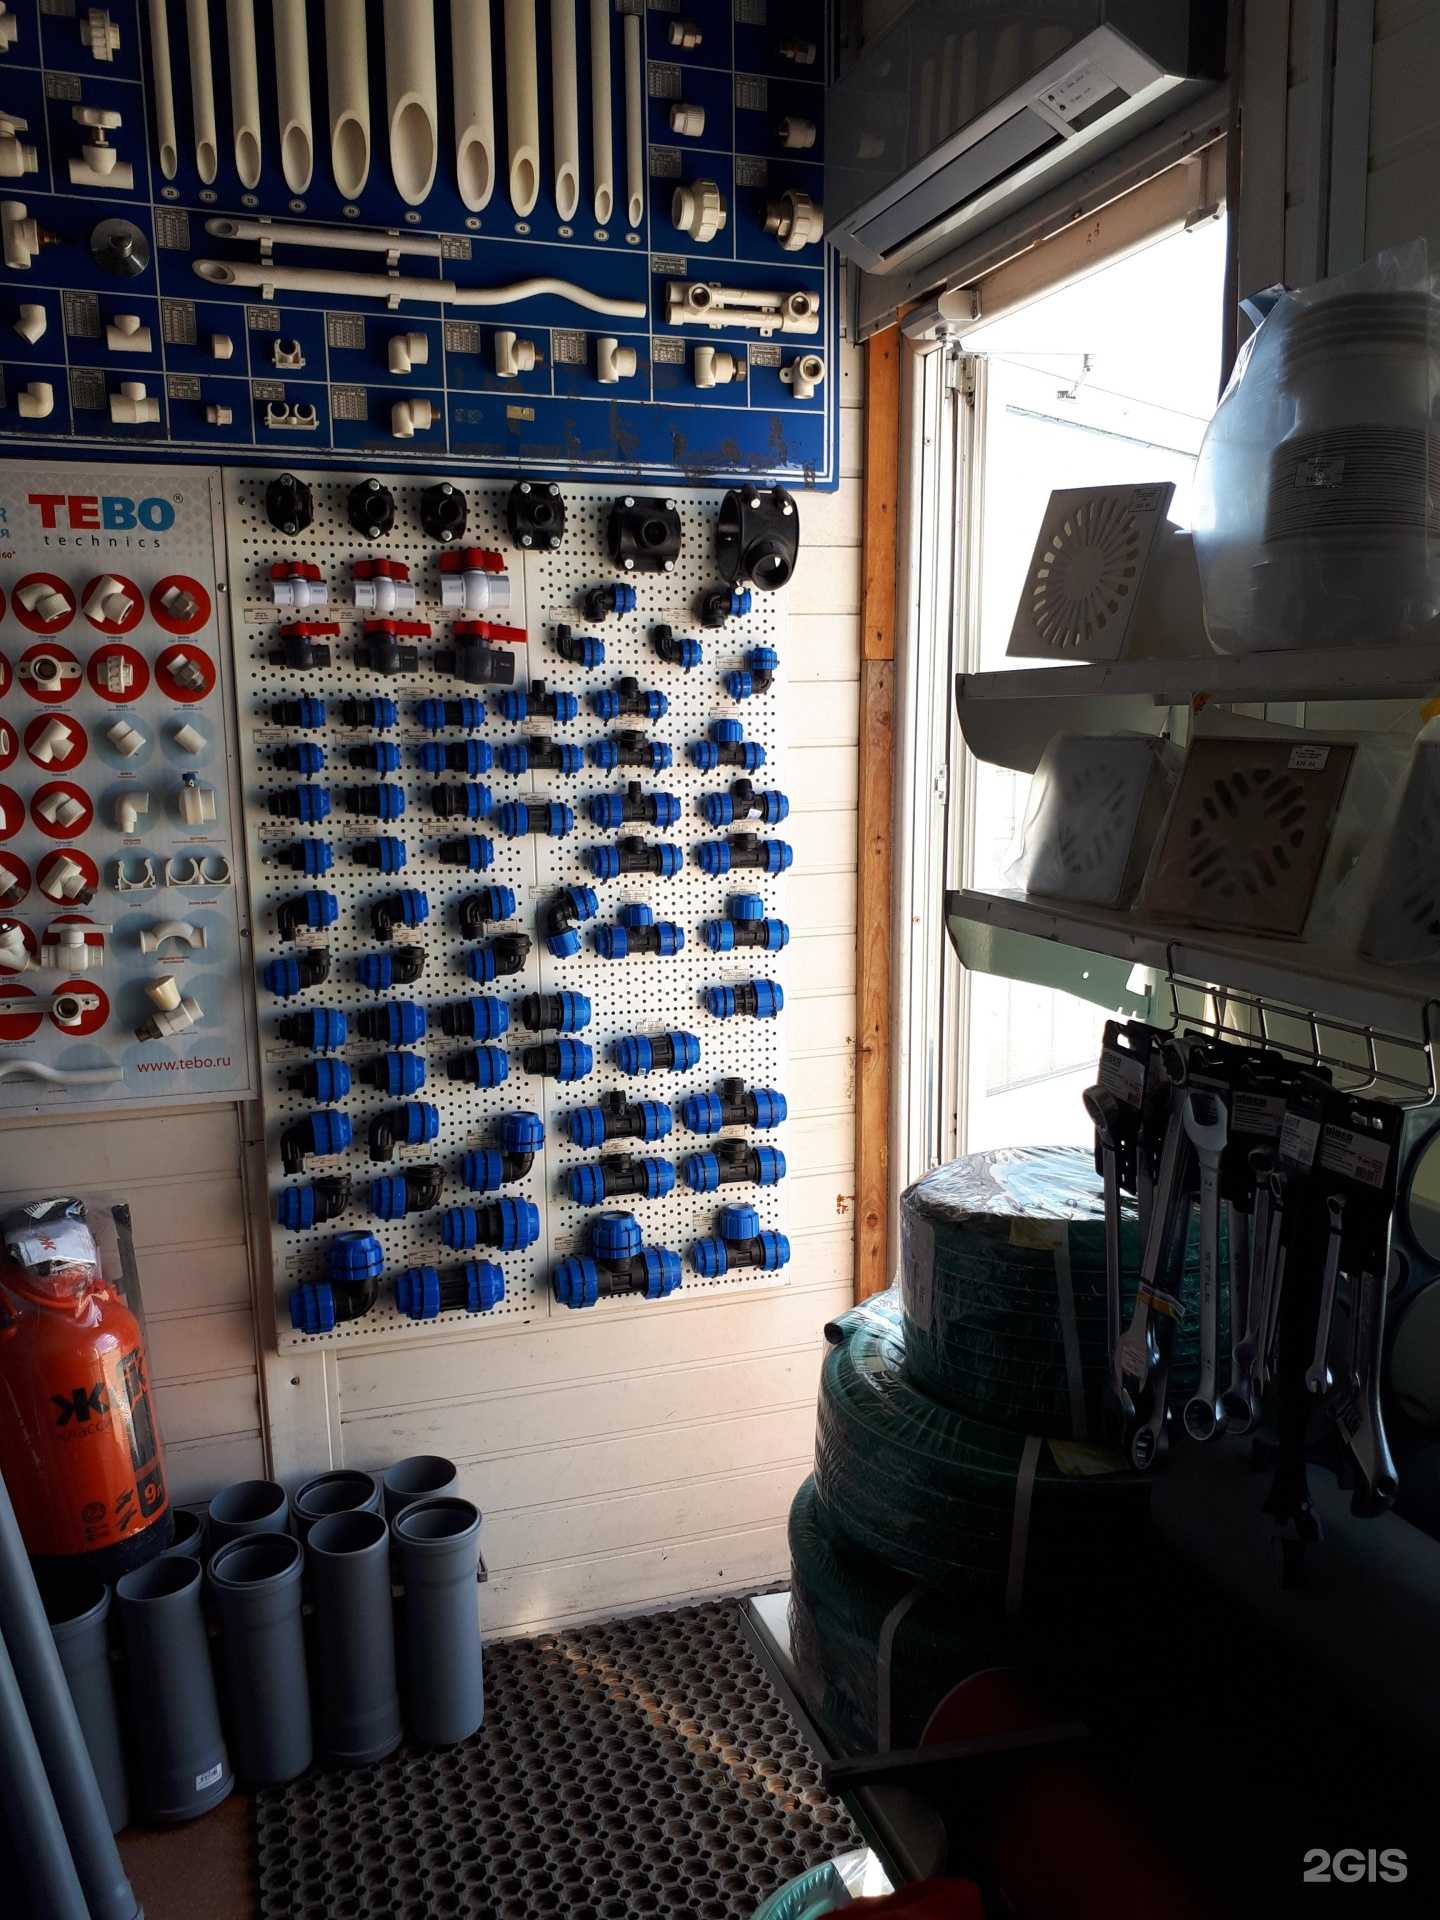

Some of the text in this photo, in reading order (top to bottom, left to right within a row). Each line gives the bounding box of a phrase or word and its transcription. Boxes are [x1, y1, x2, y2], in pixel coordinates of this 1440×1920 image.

[28, 493, 176, 532] TEBO
[44, 534, 161, 549] technics
[137, 1055, 232, 1074] www.tebo.ru
